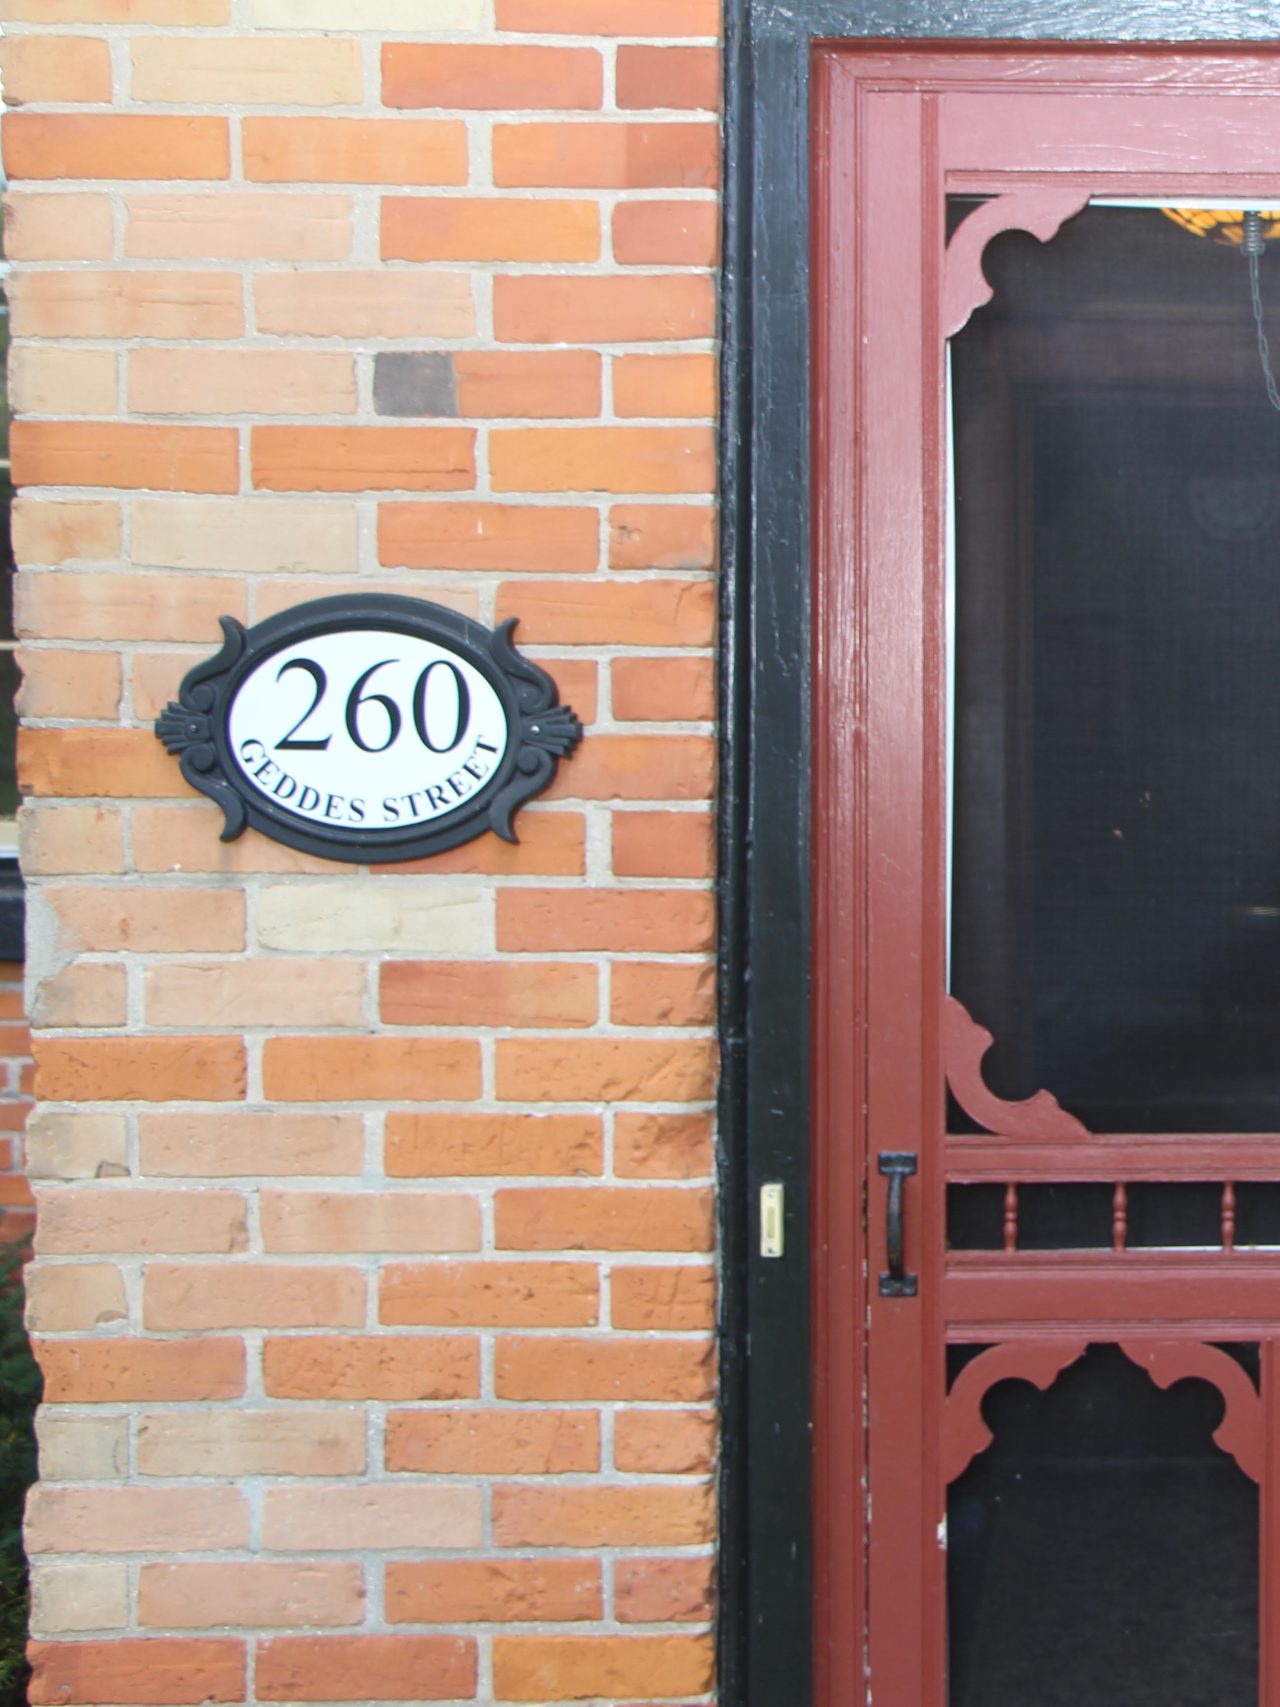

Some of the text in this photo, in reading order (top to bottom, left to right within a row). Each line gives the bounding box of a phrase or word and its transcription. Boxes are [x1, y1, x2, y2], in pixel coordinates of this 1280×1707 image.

[273, 657, 471, 754] 260
[239, 734, 500, 823] GEDDES STREET
